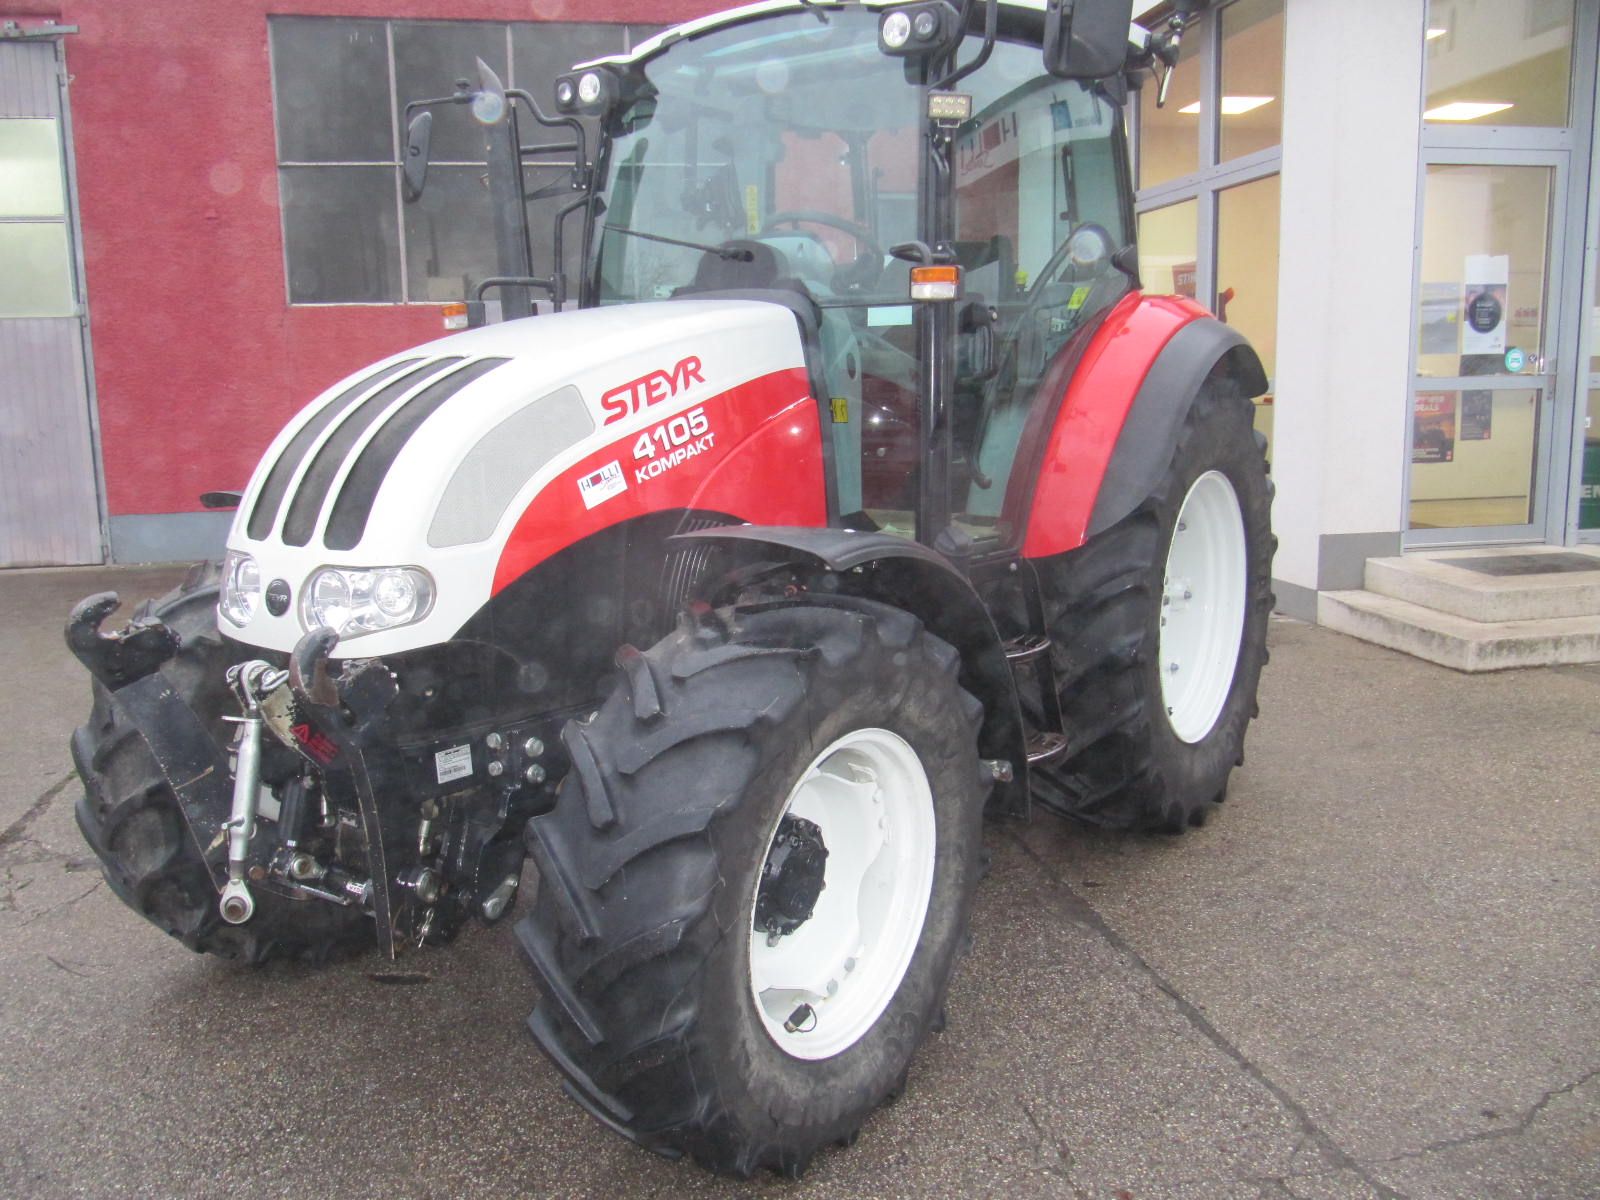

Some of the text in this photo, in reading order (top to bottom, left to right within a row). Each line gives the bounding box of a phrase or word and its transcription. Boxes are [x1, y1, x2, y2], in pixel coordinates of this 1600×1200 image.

[601, 355, 706, 427] STEYR
[632, 407, 709, 460] 4105
[635, 433, 716, 484] KOMPAKT
